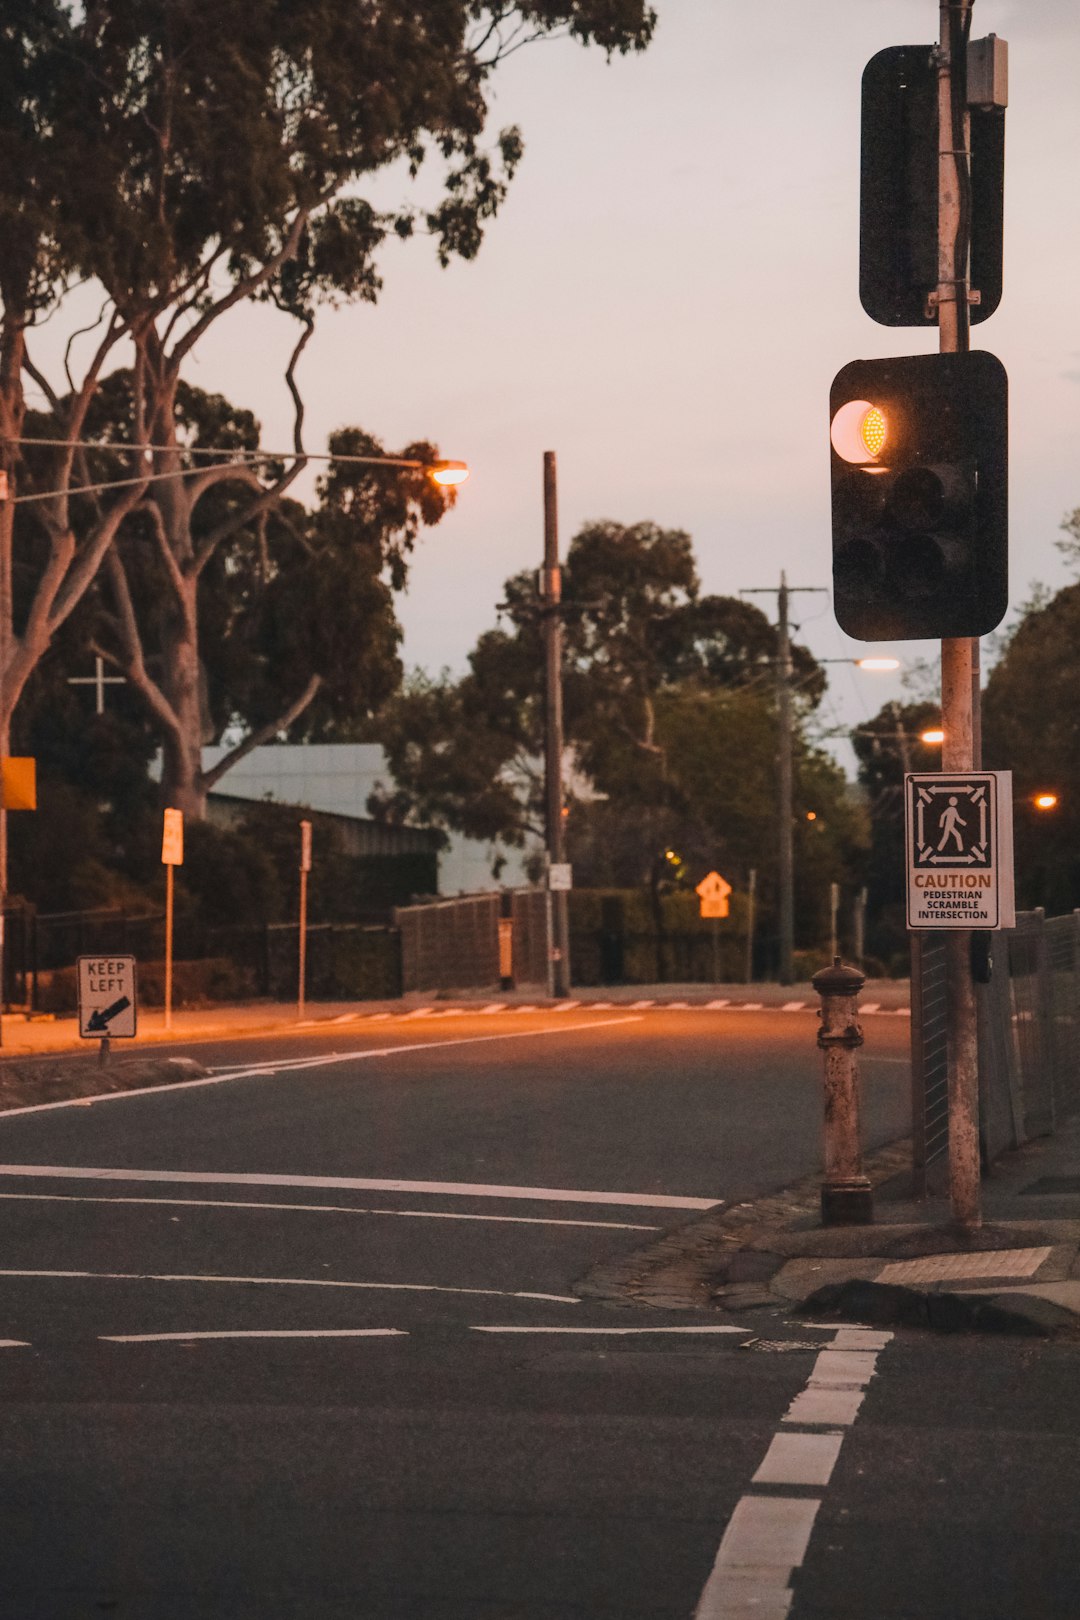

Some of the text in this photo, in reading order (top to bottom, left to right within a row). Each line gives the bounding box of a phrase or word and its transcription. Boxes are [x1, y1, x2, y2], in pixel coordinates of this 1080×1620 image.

[914, 874, 991, 888] CAUTION
[923, 891, 982, 899] PEDESTRIAN
[927, 901, 979, 909] SCRAMBLE
[918, 911, 988, 919] INTERSECTION
[88, 962, 125, 975] KEEP
[90, 979, 124, 992] LEFT
